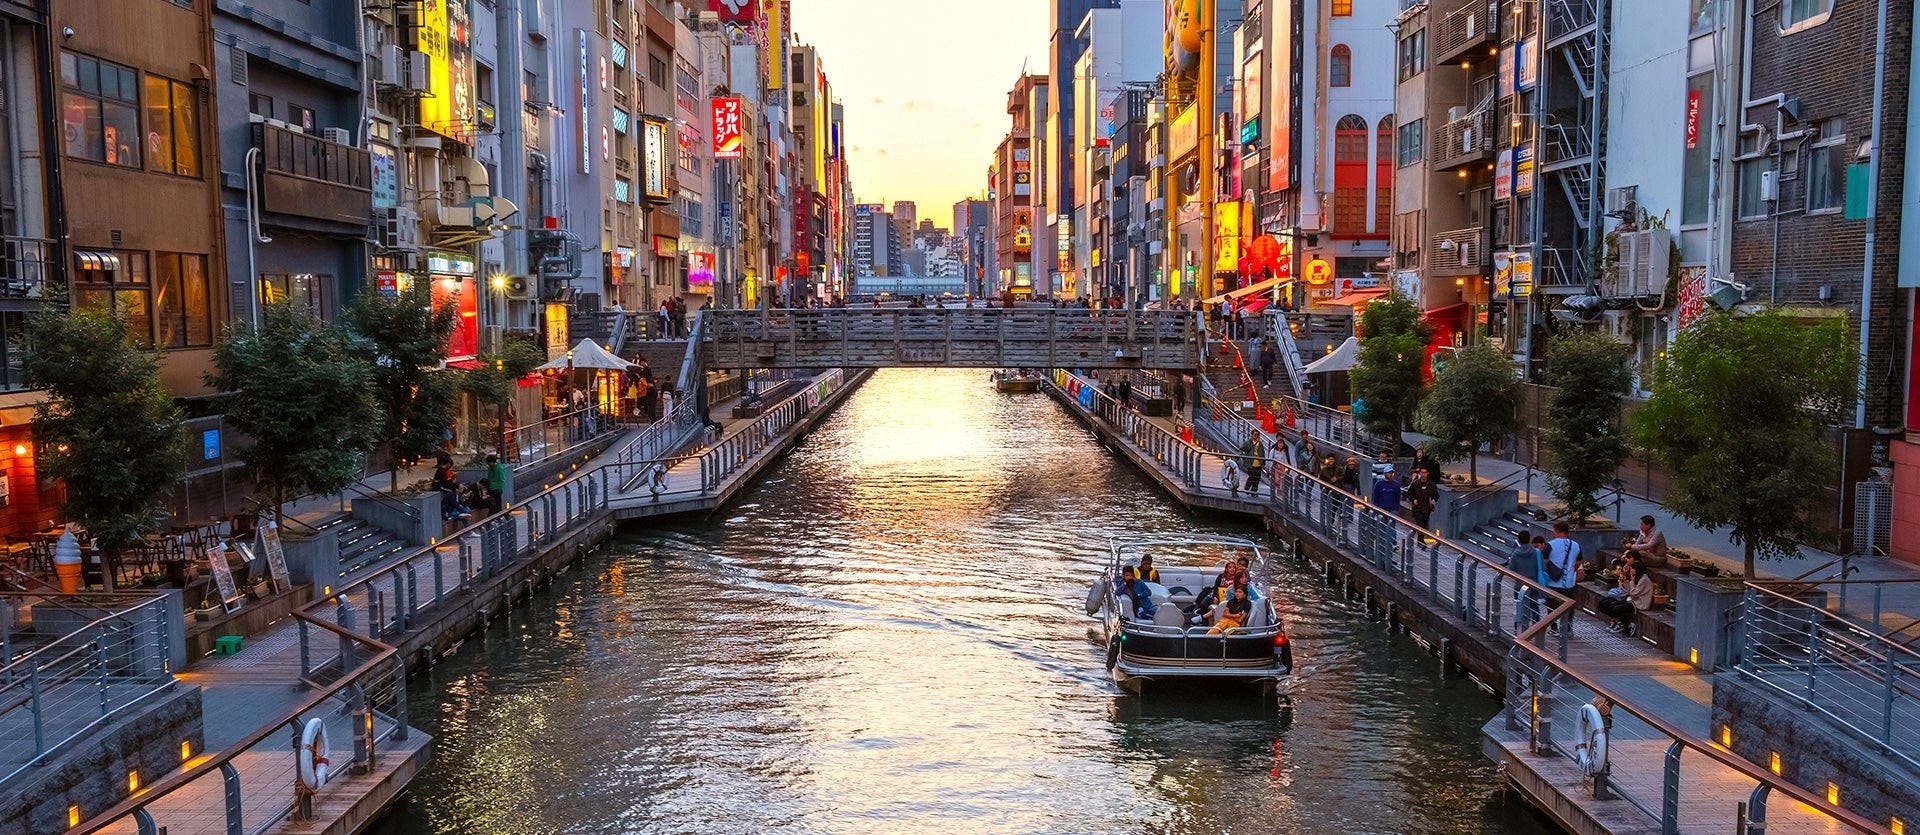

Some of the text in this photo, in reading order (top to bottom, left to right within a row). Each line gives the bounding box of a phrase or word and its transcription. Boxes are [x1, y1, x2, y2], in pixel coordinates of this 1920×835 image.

[715, 107, 726, 143] ドラッグ
[725, 101, 738, 135] ツルハ
